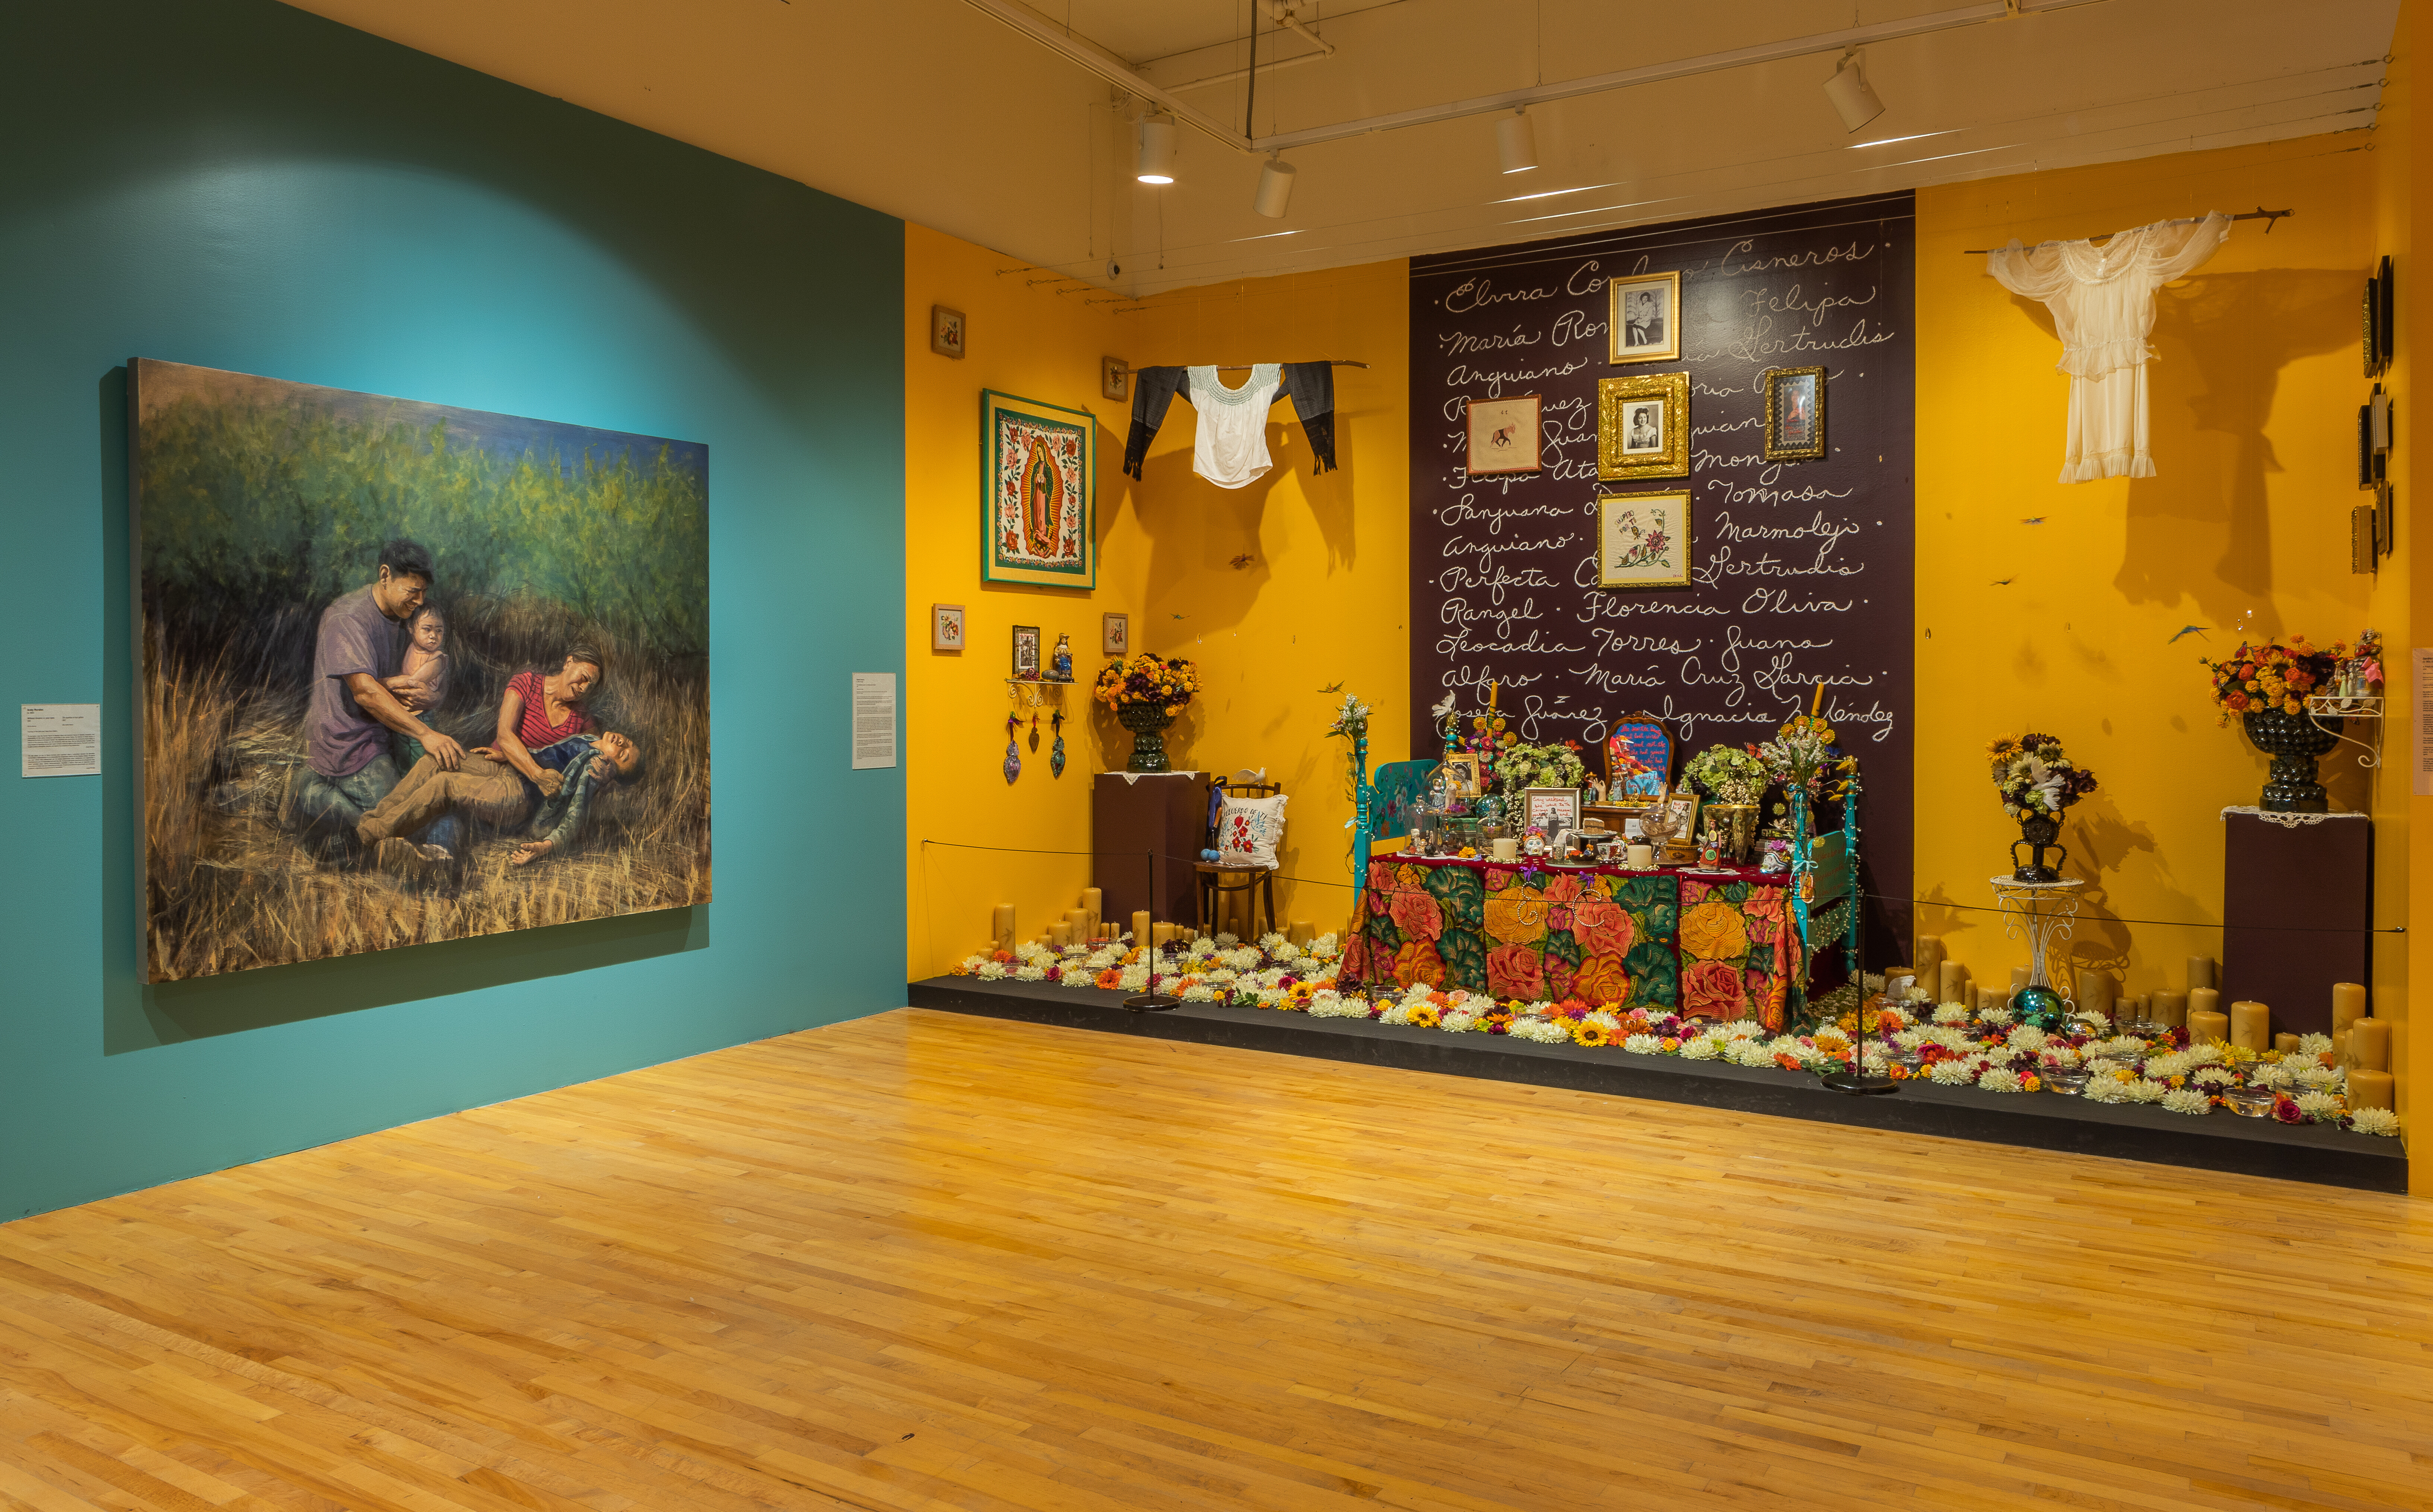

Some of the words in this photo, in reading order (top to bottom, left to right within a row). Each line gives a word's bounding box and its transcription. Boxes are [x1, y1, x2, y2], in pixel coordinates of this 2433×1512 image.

[1722, 239, 1874, 276] Cisneros
[1439, 325, 1541, 356] María
[1739, 283, 1875, 326] Felipa
[1447, 355, 1587, 399] Anguiano
[1728, 315, 1894, 362] Gertrudis
[1708, 480, 1853, 507] Tomasa
[1440, 566, 1559, 605] Perfecta
[1692, 546, 1864, 590] Gertrudis
[1443, 533, 1574, 574] Anguiano
[1441, 597, 1543, 639] Rangel
[1577, 591, 1730, 623] Florencia
[1742, 588, 1852, 614] Oliva
[1436, 629, 1586, 661] Leocadia
[1592, 628, 1701, 657] Torres
[1722, 626, 1833, 672] Juana
[1569, 663, 1666, 693] María
[1682, 656, 1745, 707] Cruz
